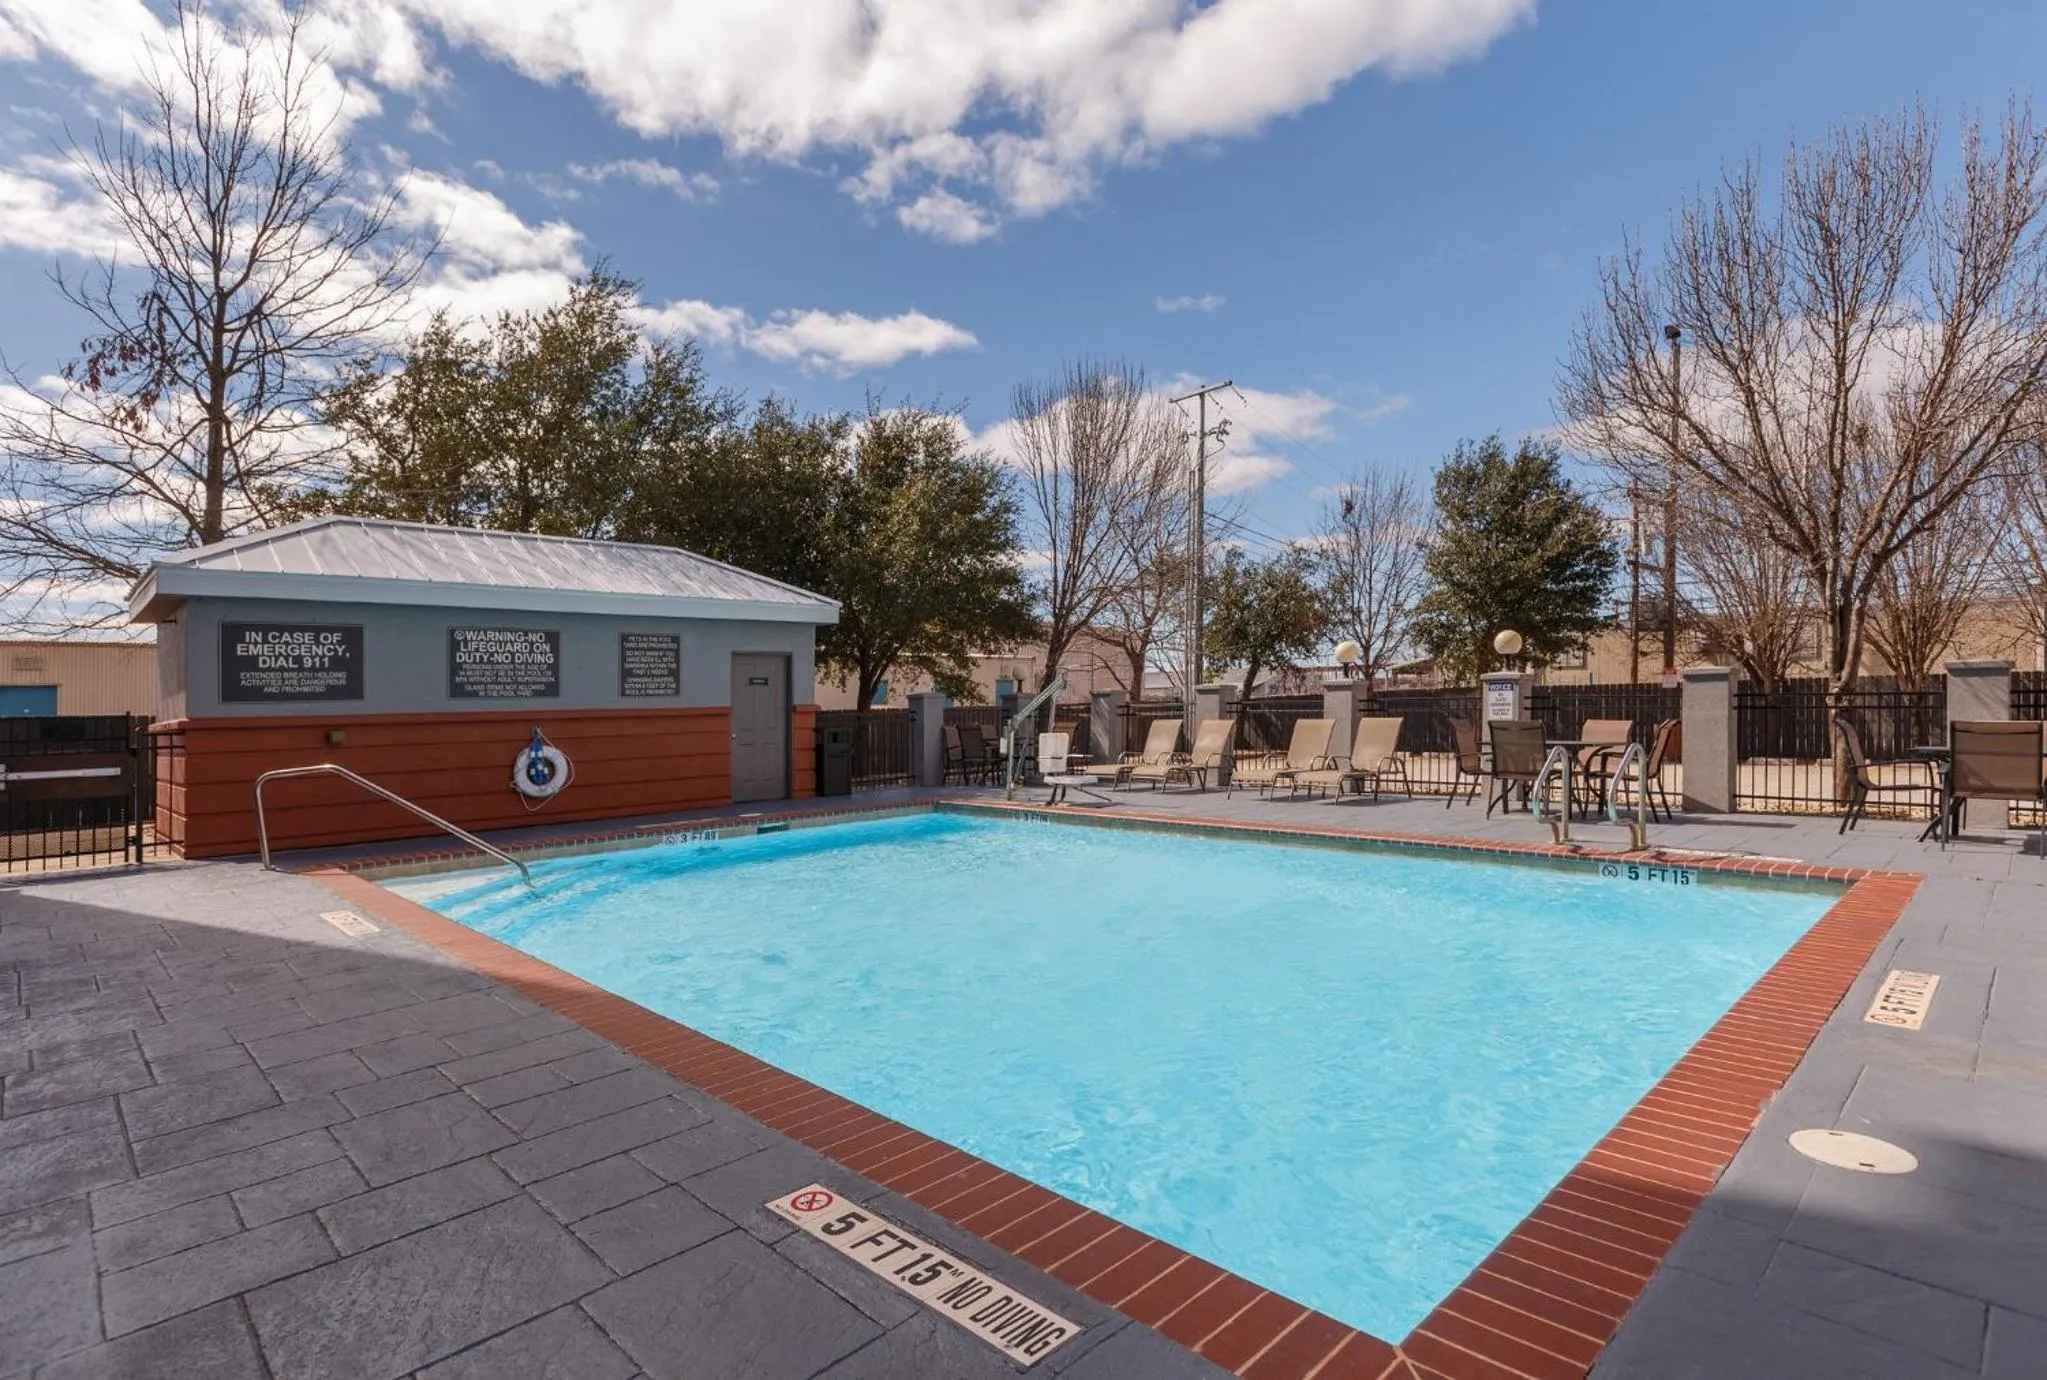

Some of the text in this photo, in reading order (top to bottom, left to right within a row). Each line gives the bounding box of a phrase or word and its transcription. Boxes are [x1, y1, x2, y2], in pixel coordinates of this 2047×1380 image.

[245, 631, 343, 644] IN CASE OF
[465, 631, 545, 643] WARNING-NO
[236, 643, 350, 659] EMERGENCY,
[460, 641, 551, 653] LIFEGUARD ON
[258, 656, 329, 668] DIAL 911
[455, 652, 554, 664] DUTY-NO DIVING
[681, 834, 687, 843] 3
[1628, 866, 1640, 880] 5
[1648, 868, 1669, 882] FT
[821, 1211, 869, 1236] 5
[849, 1229, 918, 1263] FT
[936, 1277, 993, 1310] NO
[969, 1295, 1067, 1357] DIVING
